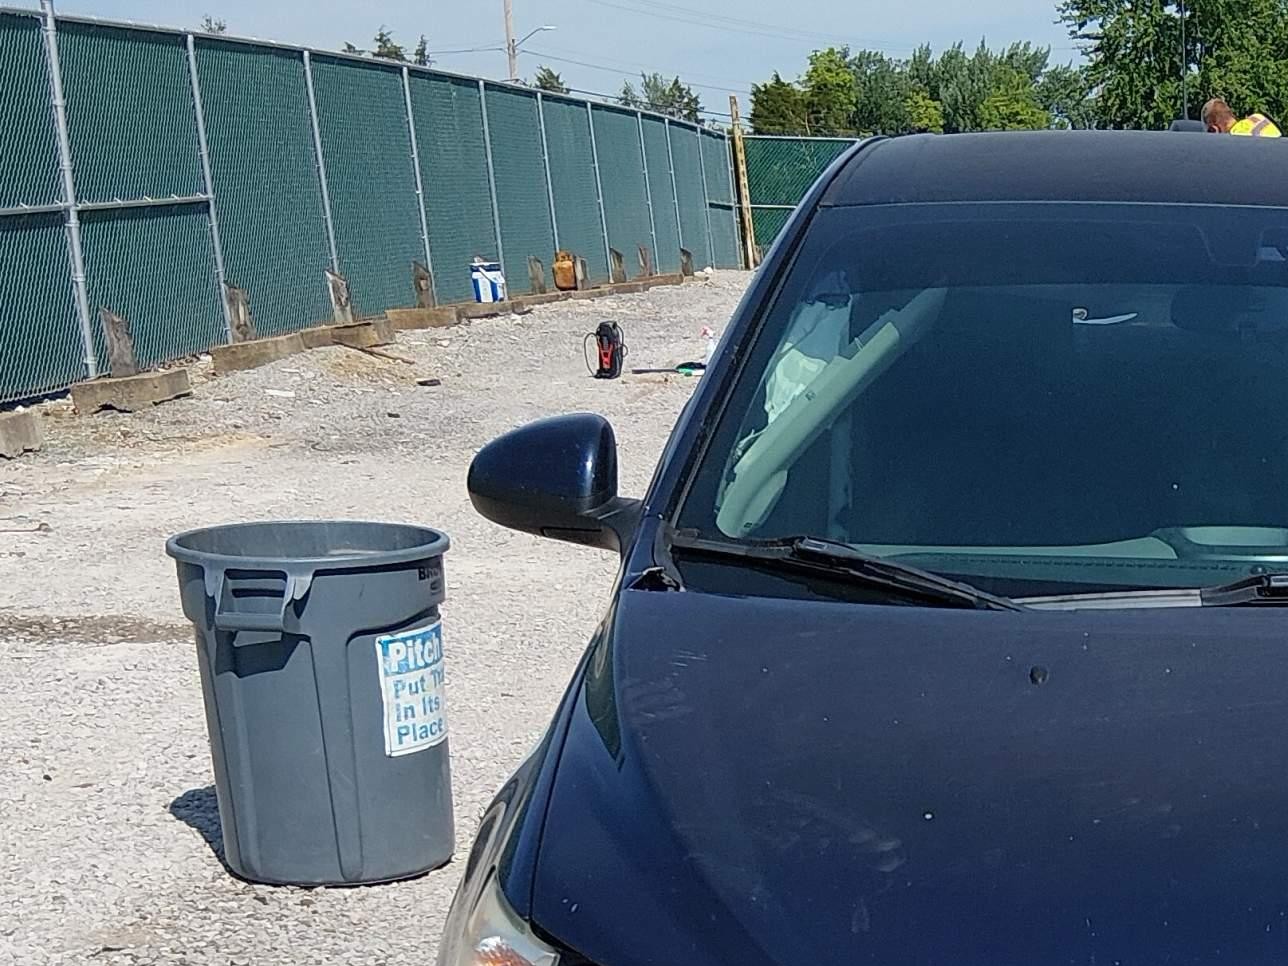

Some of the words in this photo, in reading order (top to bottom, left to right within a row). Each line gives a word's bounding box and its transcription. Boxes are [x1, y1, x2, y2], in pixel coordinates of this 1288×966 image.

[389, 631, 441, 674] Pitch
[393, 674, 426, 699] Put
[422, 695, 440, 716] Its
